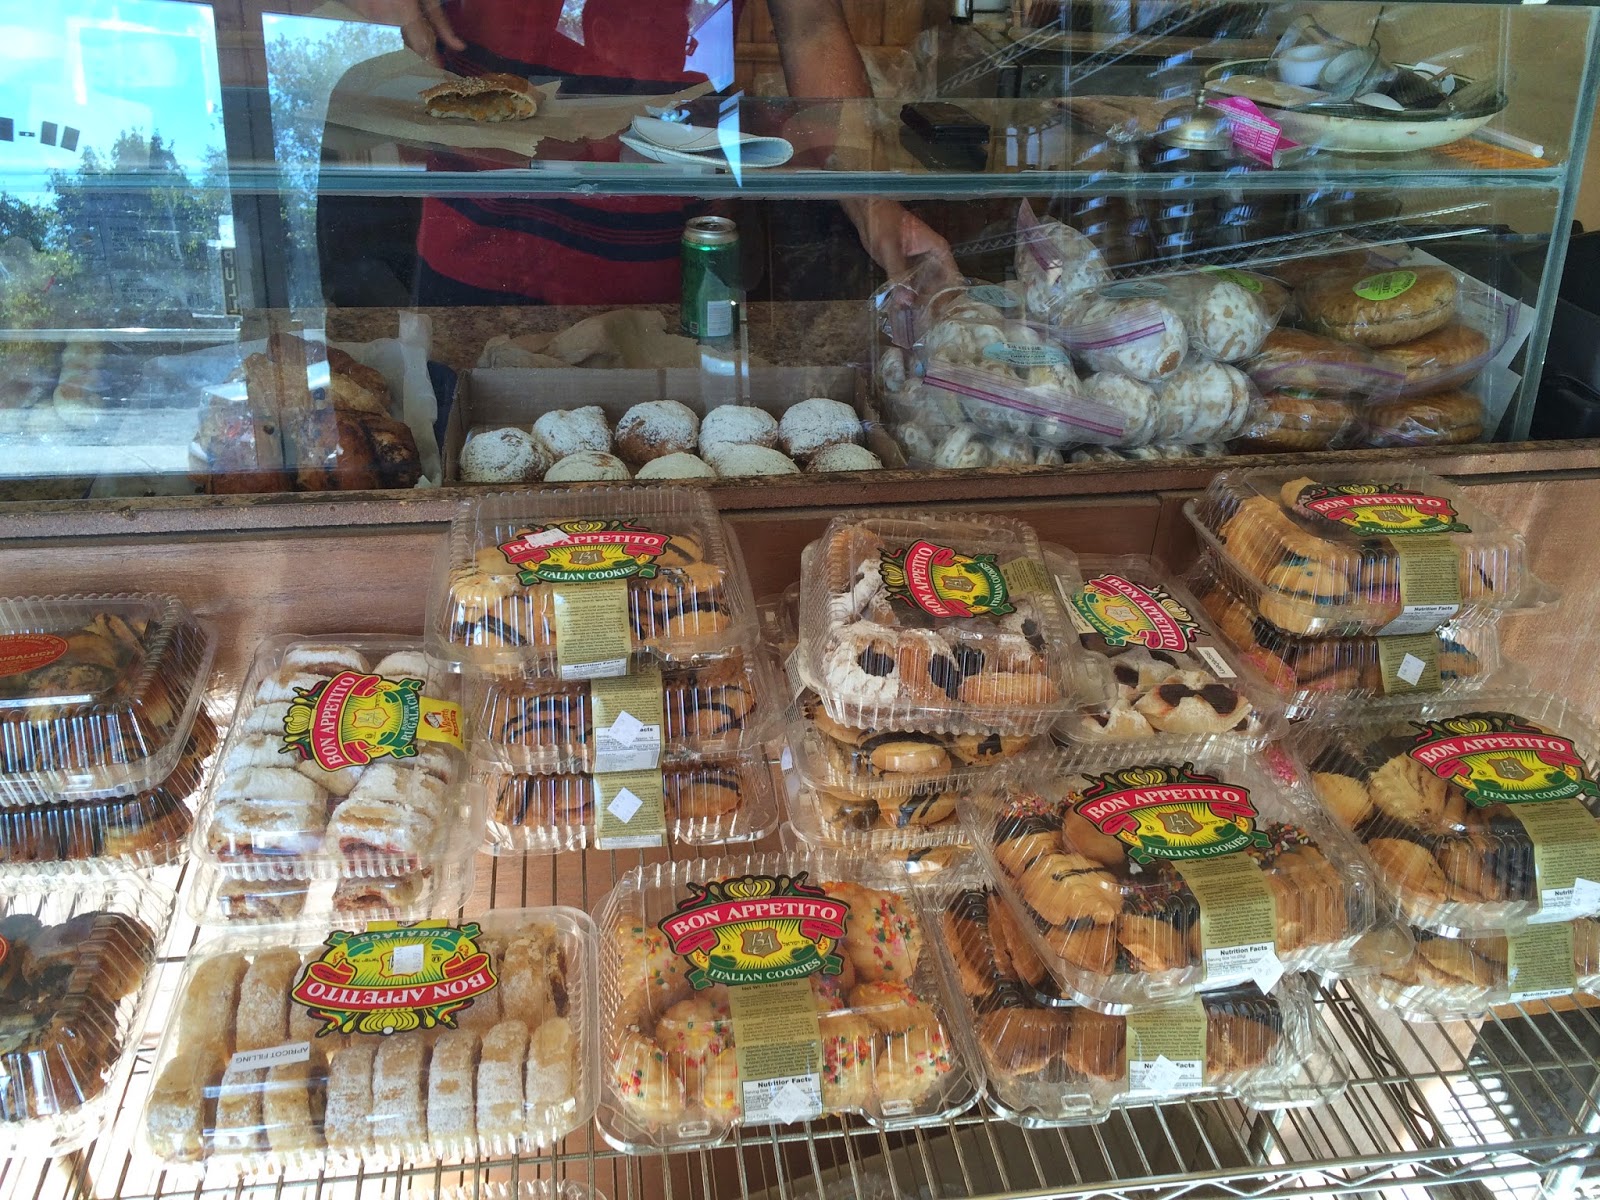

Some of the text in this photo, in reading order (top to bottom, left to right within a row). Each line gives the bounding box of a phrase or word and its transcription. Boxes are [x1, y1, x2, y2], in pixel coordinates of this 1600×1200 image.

[1313, 496, 1442, 512] BON APPETITO
[560, 534, 659, 545] APPETITO
[1364, 526, 1409, 535] ITALIAN
[539, 565, 638, 580] ITALIAN COOKIES
[911, 547, 949, 615] BON APPETITO
[978, 562, 1004, 607] ITALIAN COOKIES
[1107, 578, 1179, 647] BON APPETITO
[0, 650, 55, 662] UGALUCH
[319, 677, 356, 766] BON APPETITO
[400, 693, 419, 741] RUGALACH
[1419, 737, 1566, 763] BON APPETITO
[1482, 782, 1579, 801] ITALIAN COOKIES
[1087, 790, 1240, 819] BON APPETITO
[1147, 834, 1249, 858] ITALIAN COOKIES
[672, 902, 838, 936] BON APPETITO
[358, 930, 453, 942] RUGALACH
[709, 958, 821, 981] ITALIAN COOKIES
[306, 973, 486, 1005] BON APPETITO
[236, 1046, 308, 1064] APRICOT FILLING
[791, 1076, 812, 1084] Facts
